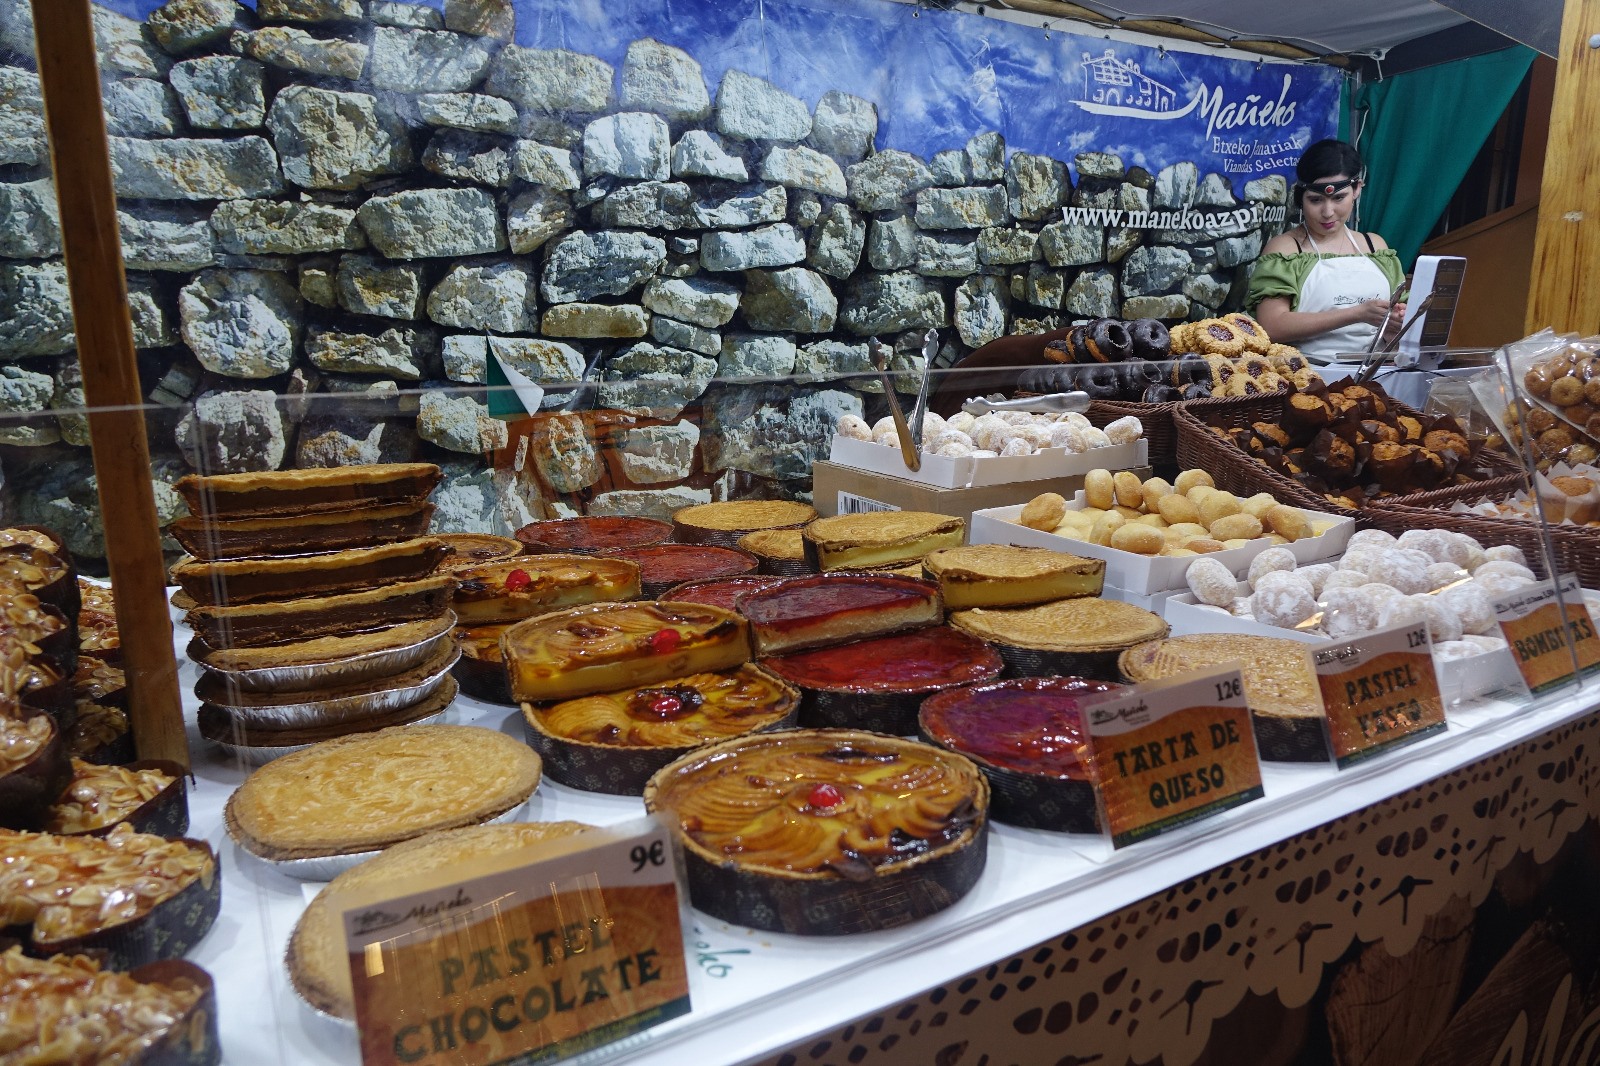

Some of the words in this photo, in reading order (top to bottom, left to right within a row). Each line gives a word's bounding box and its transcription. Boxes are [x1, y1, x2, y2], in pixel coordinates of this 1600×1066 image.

[1196, 73, 1297, 141] Mañeko
[1212, 136, 1251, 156] Etxeko
[1248, 136, 1302, 159] Janariak
[1223, 158, 1253, 173] Viandas
[1061, 201, 1287, 231] www.manekoazpi.com
[1407, 628, 1427, 649] 12€
[1215, 677, 1243, 702] 12€
[1344, 663, 1418, 706] PASTEL
[1113, 730, 1200, 778] TARTA
[1208, 718, 1241, 750] DE
[1148, 762, 1225, 810] QUESO
[630, 839, 666, 873] 9€
[439, 917, 614, 996] PASTEL
[392, 947, 662, 1064] CHOCOLATE
